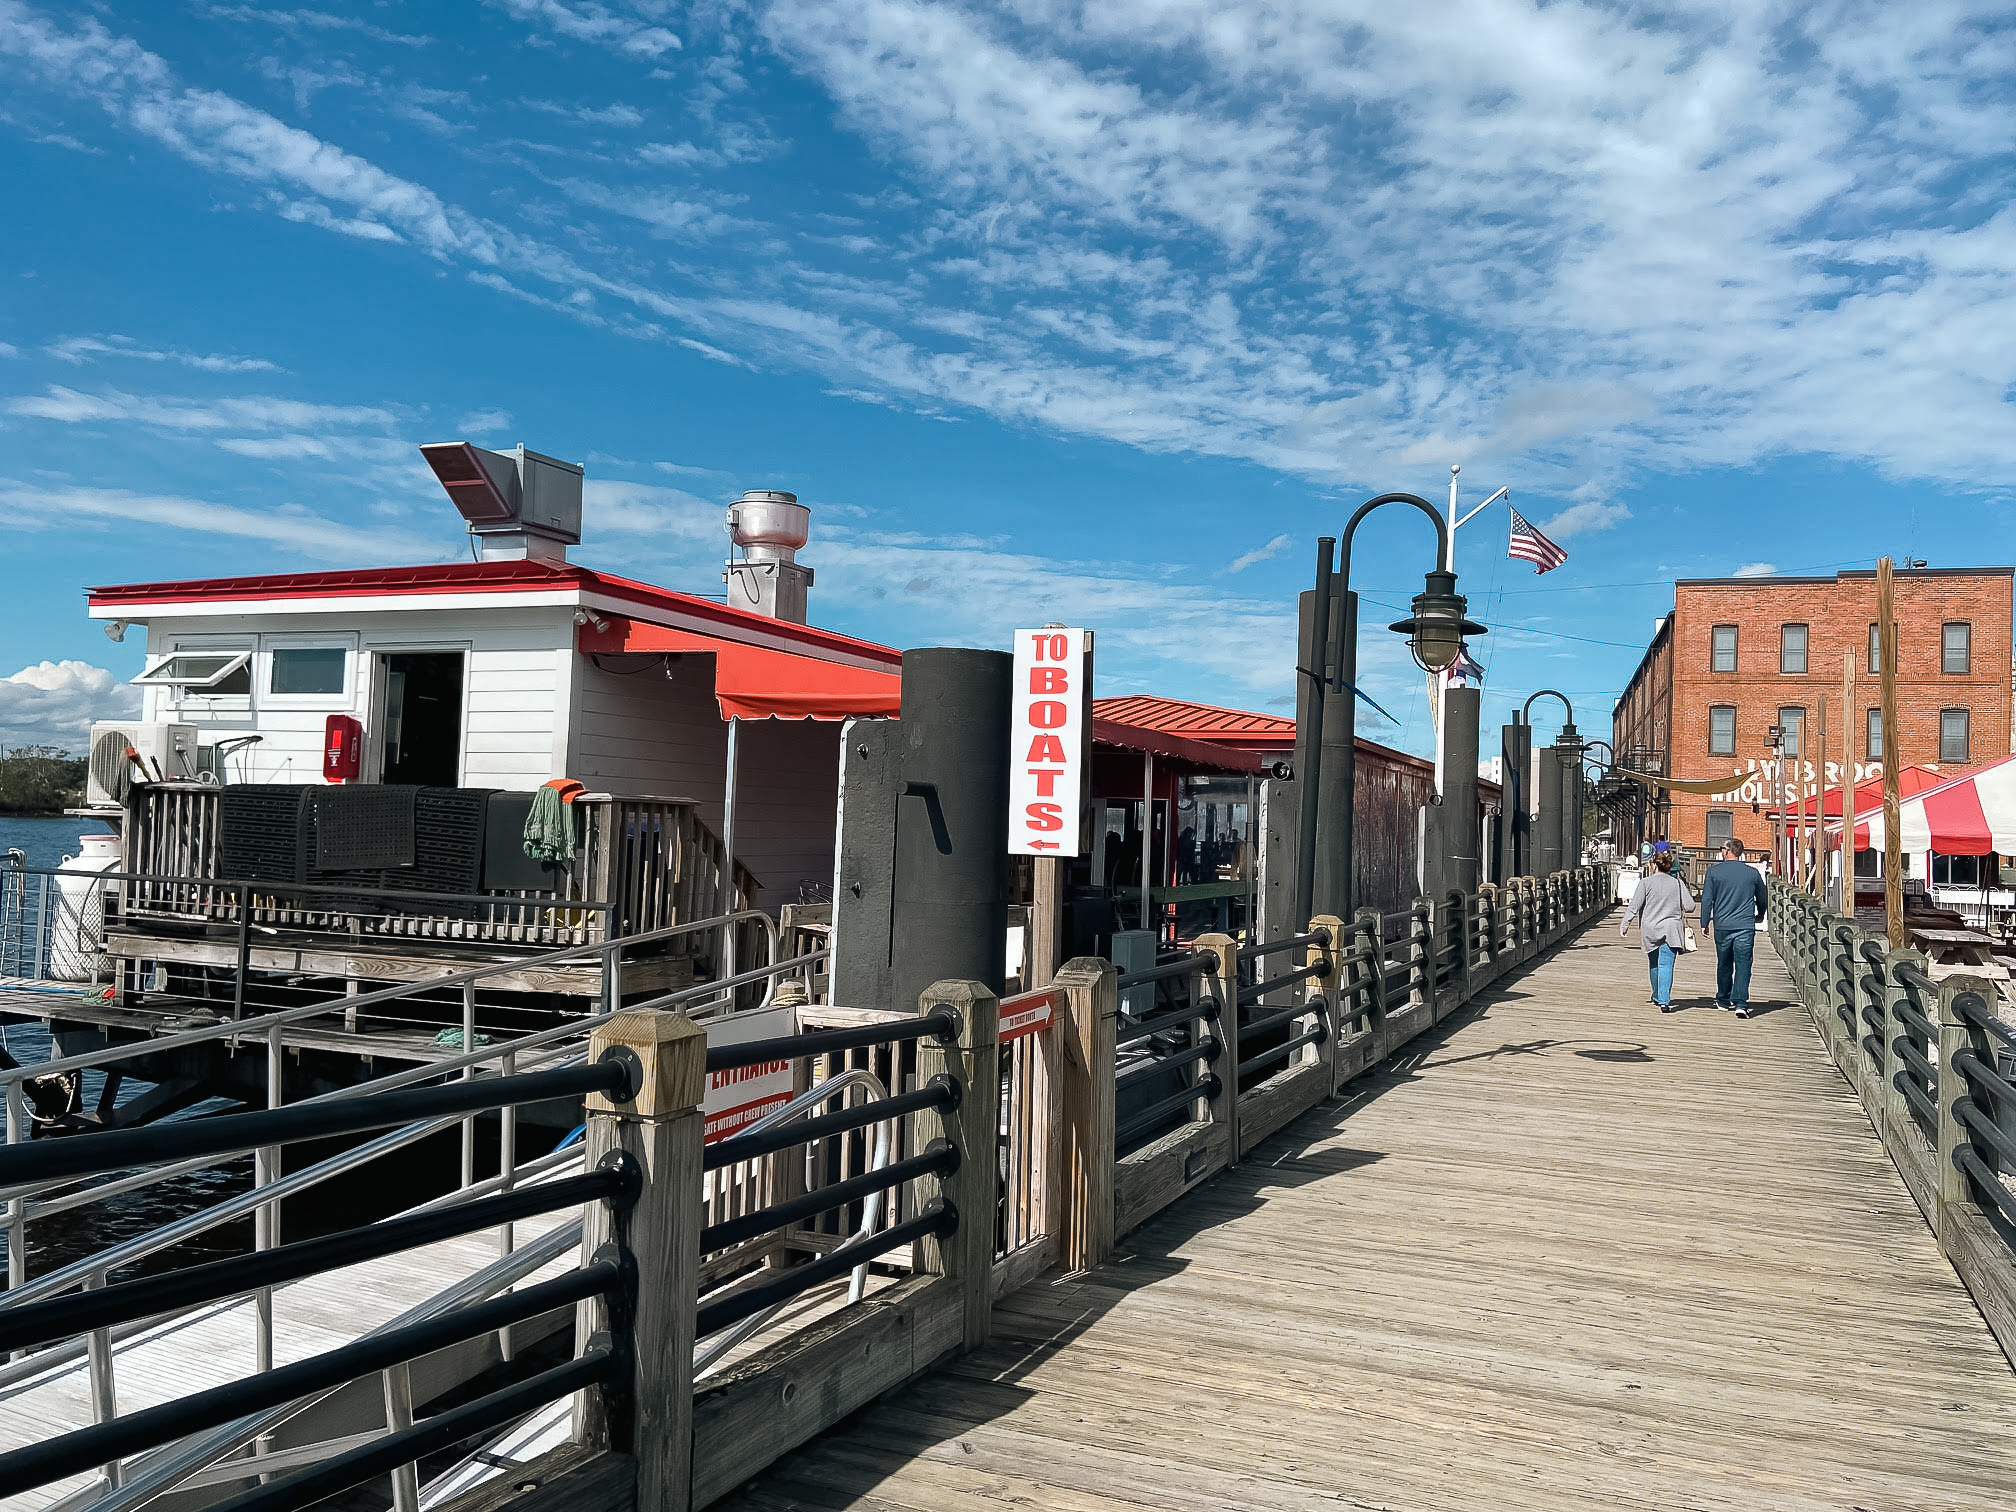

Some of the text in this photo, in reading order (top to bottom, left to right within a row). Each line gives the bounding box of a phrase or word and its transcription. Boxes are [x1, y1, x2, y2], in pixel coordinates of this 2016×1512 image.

[1031, 633, 1068, 662] TO
[1025, 666, 1069, 832] BOATS
[717, 1112, 744, 1132] WITHOUT
[744, 1106, 761, 1122] CREW
